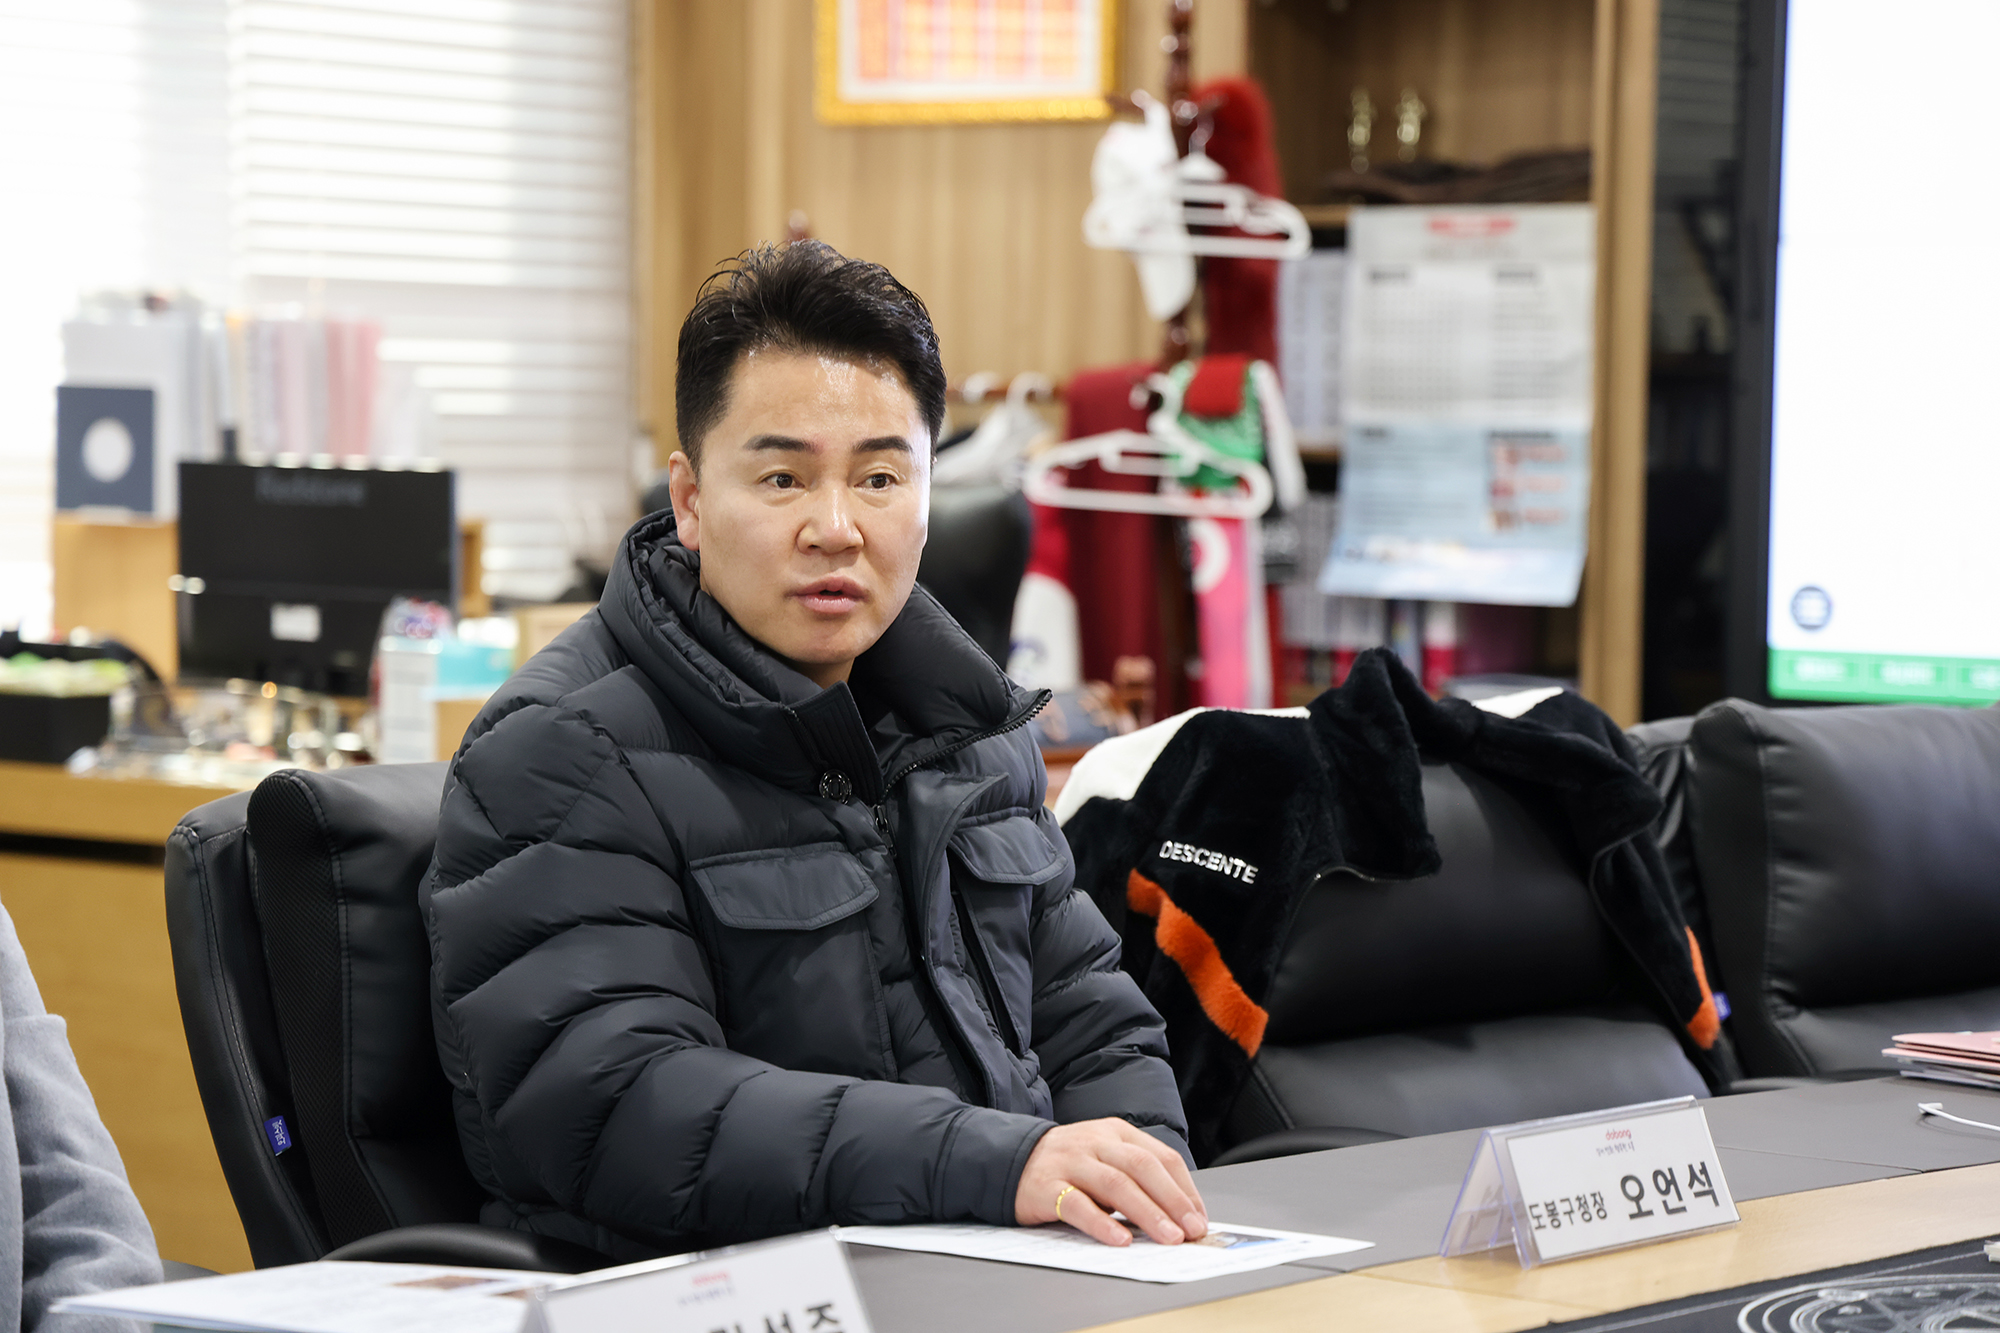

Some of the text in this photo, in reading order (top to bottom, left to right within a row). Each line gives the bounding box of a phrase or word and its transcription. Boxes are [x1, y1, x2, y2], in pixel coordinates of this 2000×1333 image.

[1159, 840, 1259, 884] DESCENTE
[1528, 1160, 1720, 1230] 도봉구청장 오언석
